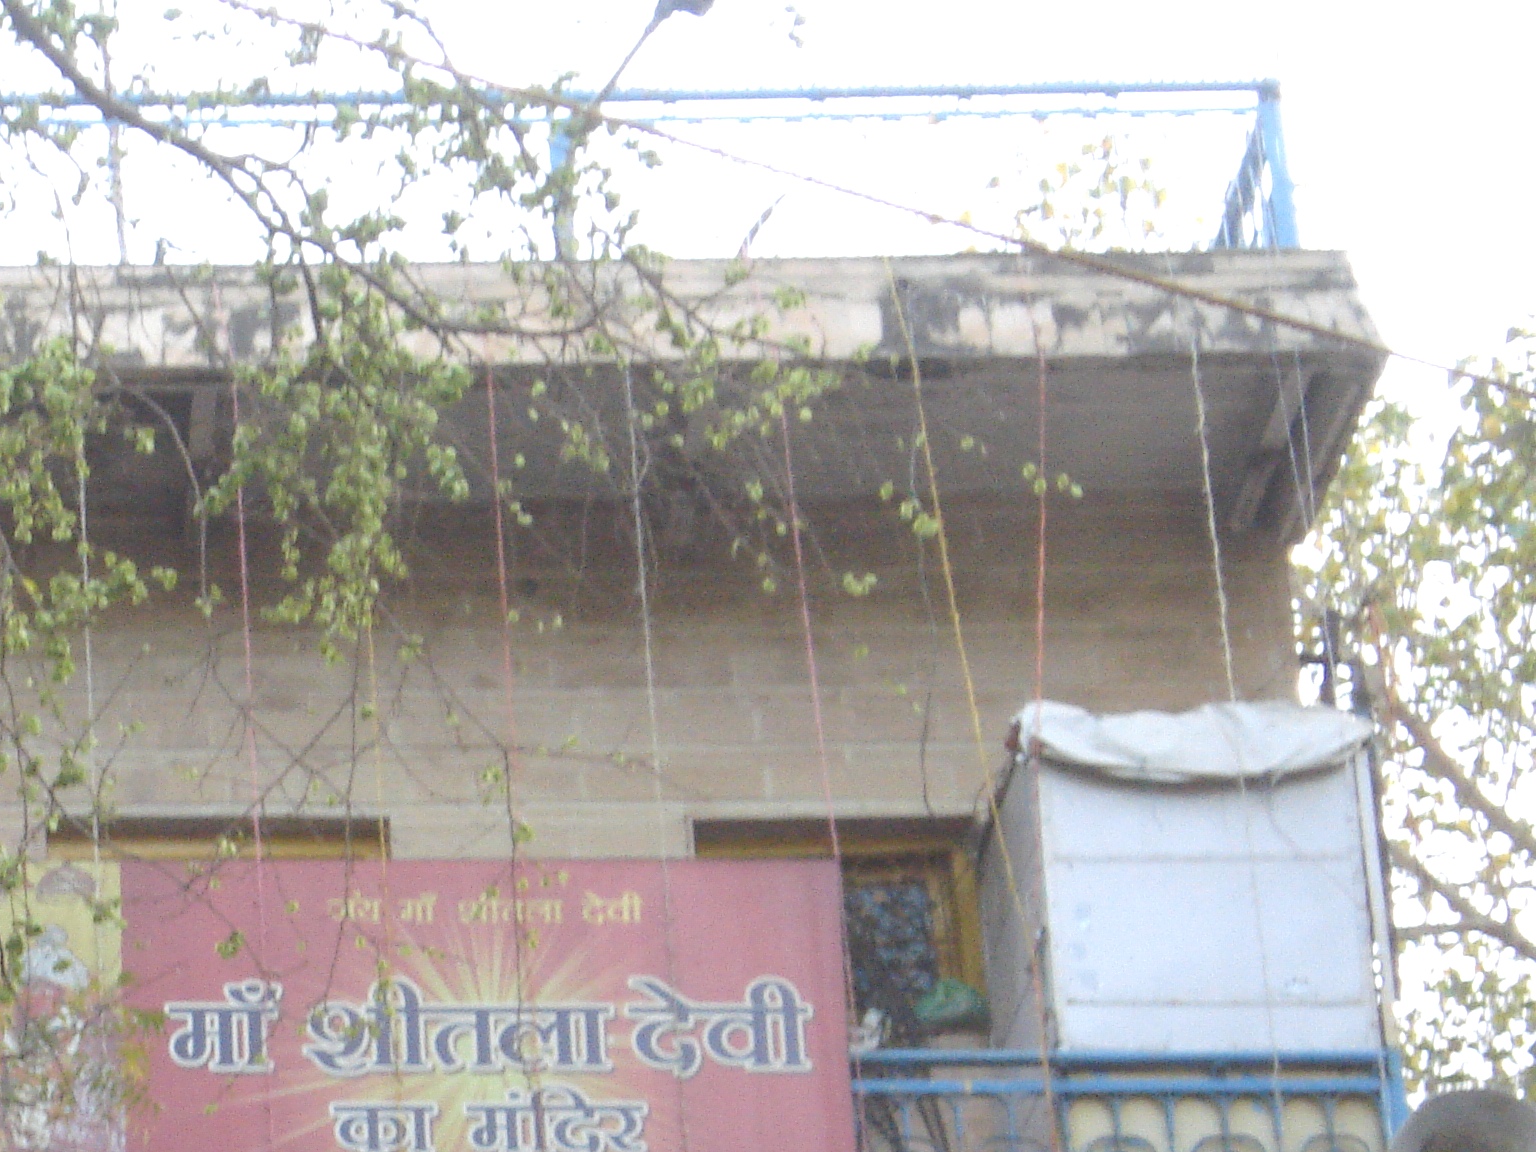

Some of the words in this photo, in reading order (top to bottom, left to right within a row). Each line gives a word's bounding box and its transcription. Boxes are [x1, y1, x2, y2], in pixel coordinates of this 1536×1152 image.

[581, 890, 642, 926] देवी
[302, 975, 620, 1078] शीतला
[624, 975, 816, 1079] देवी
